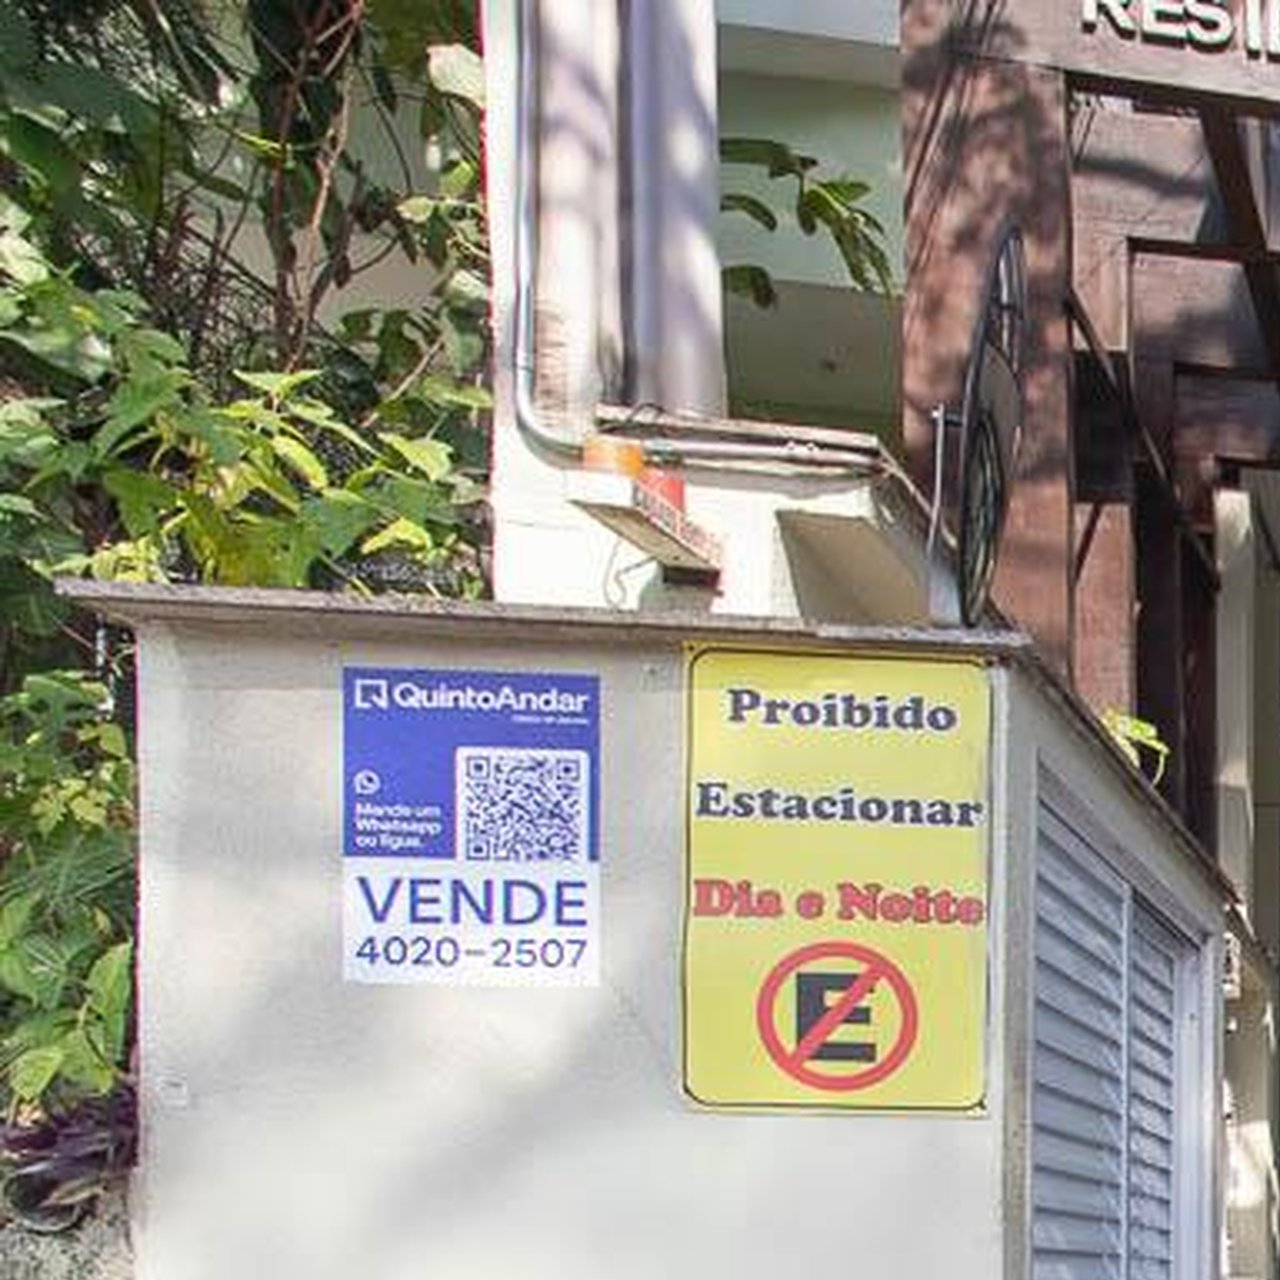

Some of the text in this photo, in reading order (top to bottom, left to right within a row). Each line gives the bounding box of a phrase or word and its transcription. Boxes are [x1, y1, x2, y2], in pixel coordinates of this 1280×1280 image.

[393, 682, 589, 712] QuintoAndar
[727, 689, 957, 731] Proibido
[696, 782, 983, 827] Estacionar
[356, 877, 588, 926] VENDE
[693, 879, 984, 925] Dia e Noite
[356, 936, 588, 968] 4020-2507
